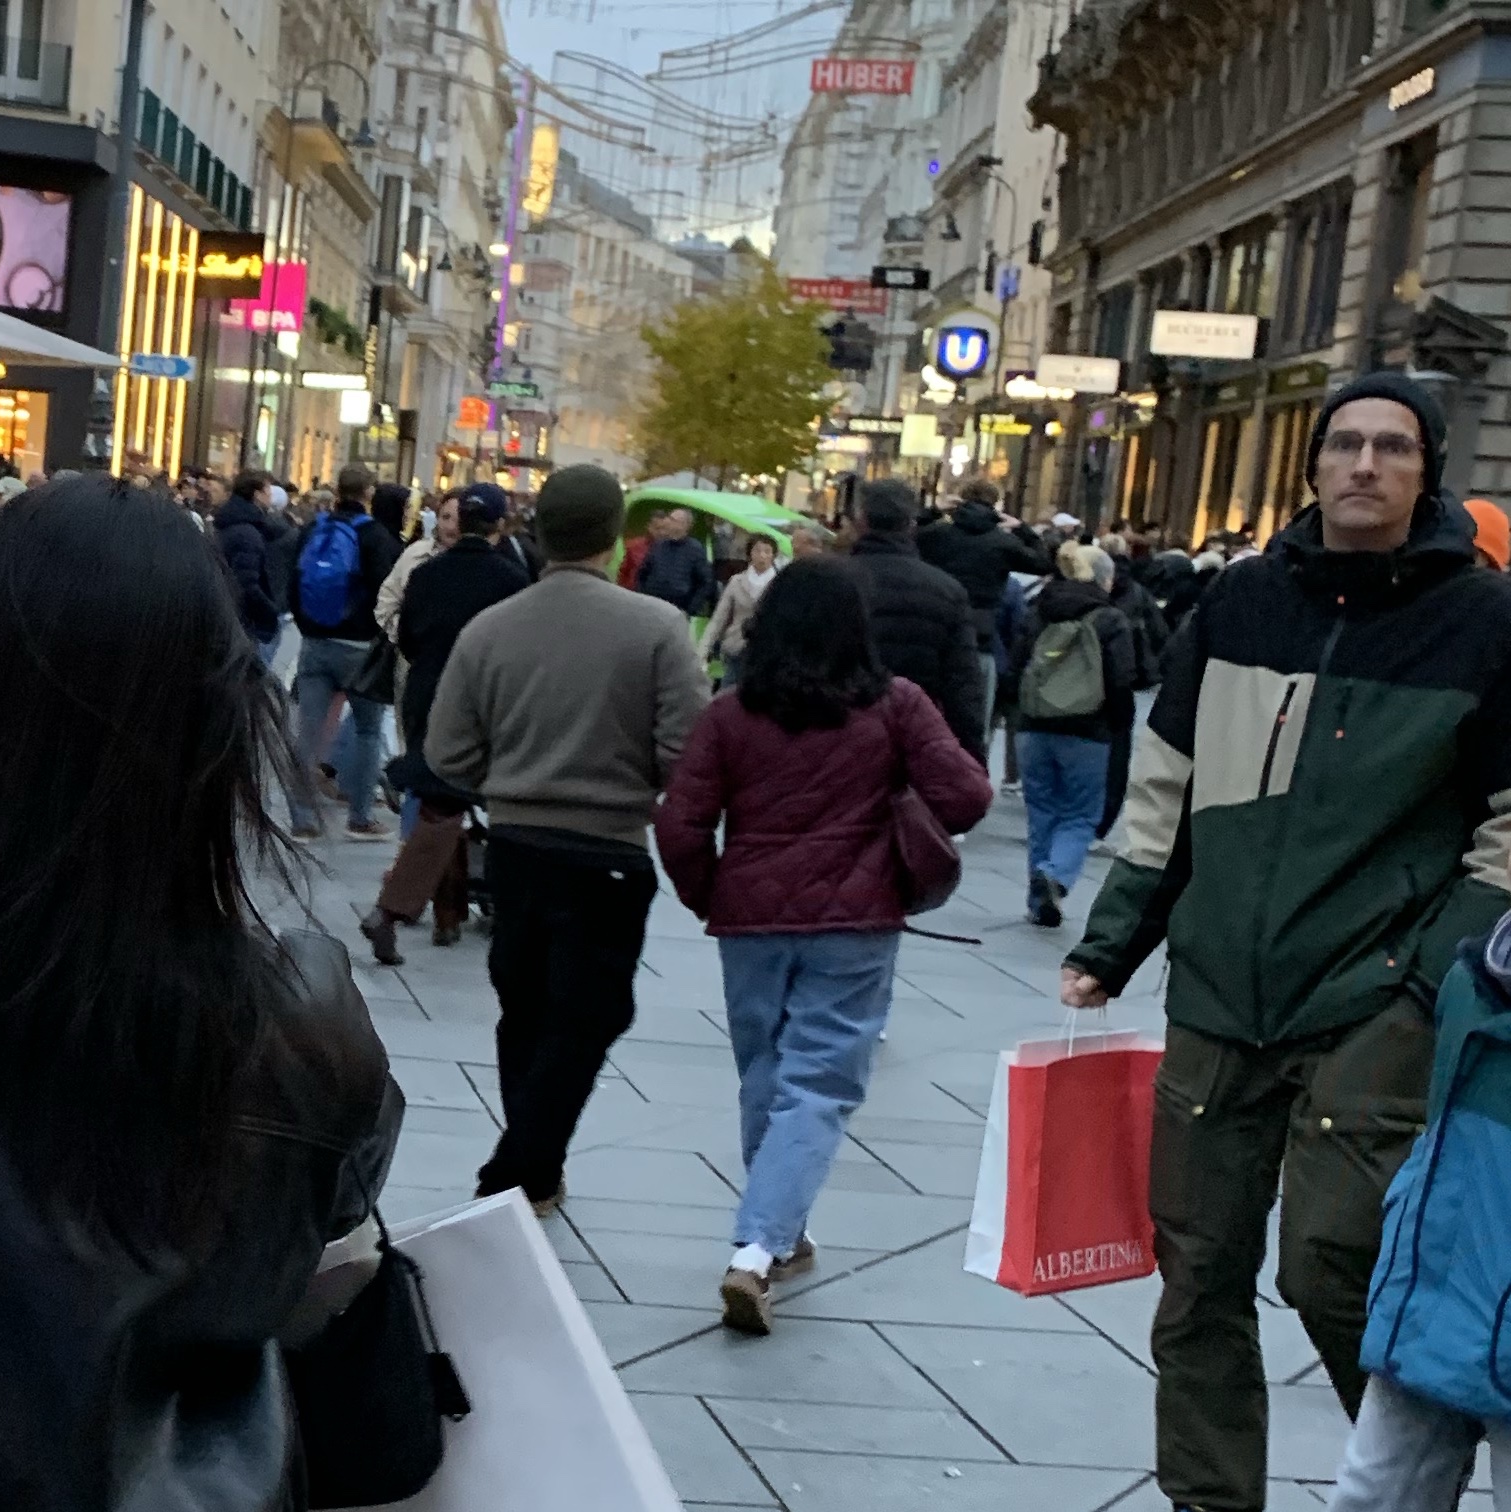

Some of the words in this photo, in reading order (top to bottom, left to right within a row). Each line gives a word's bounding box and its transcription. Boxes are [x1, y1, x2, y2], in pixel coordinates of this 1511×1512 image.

[815, 62, 904, 90] HUBER
[945, 333, 983, 371] U
[1032, 1239, 1144, 1284] ALBERTINA
